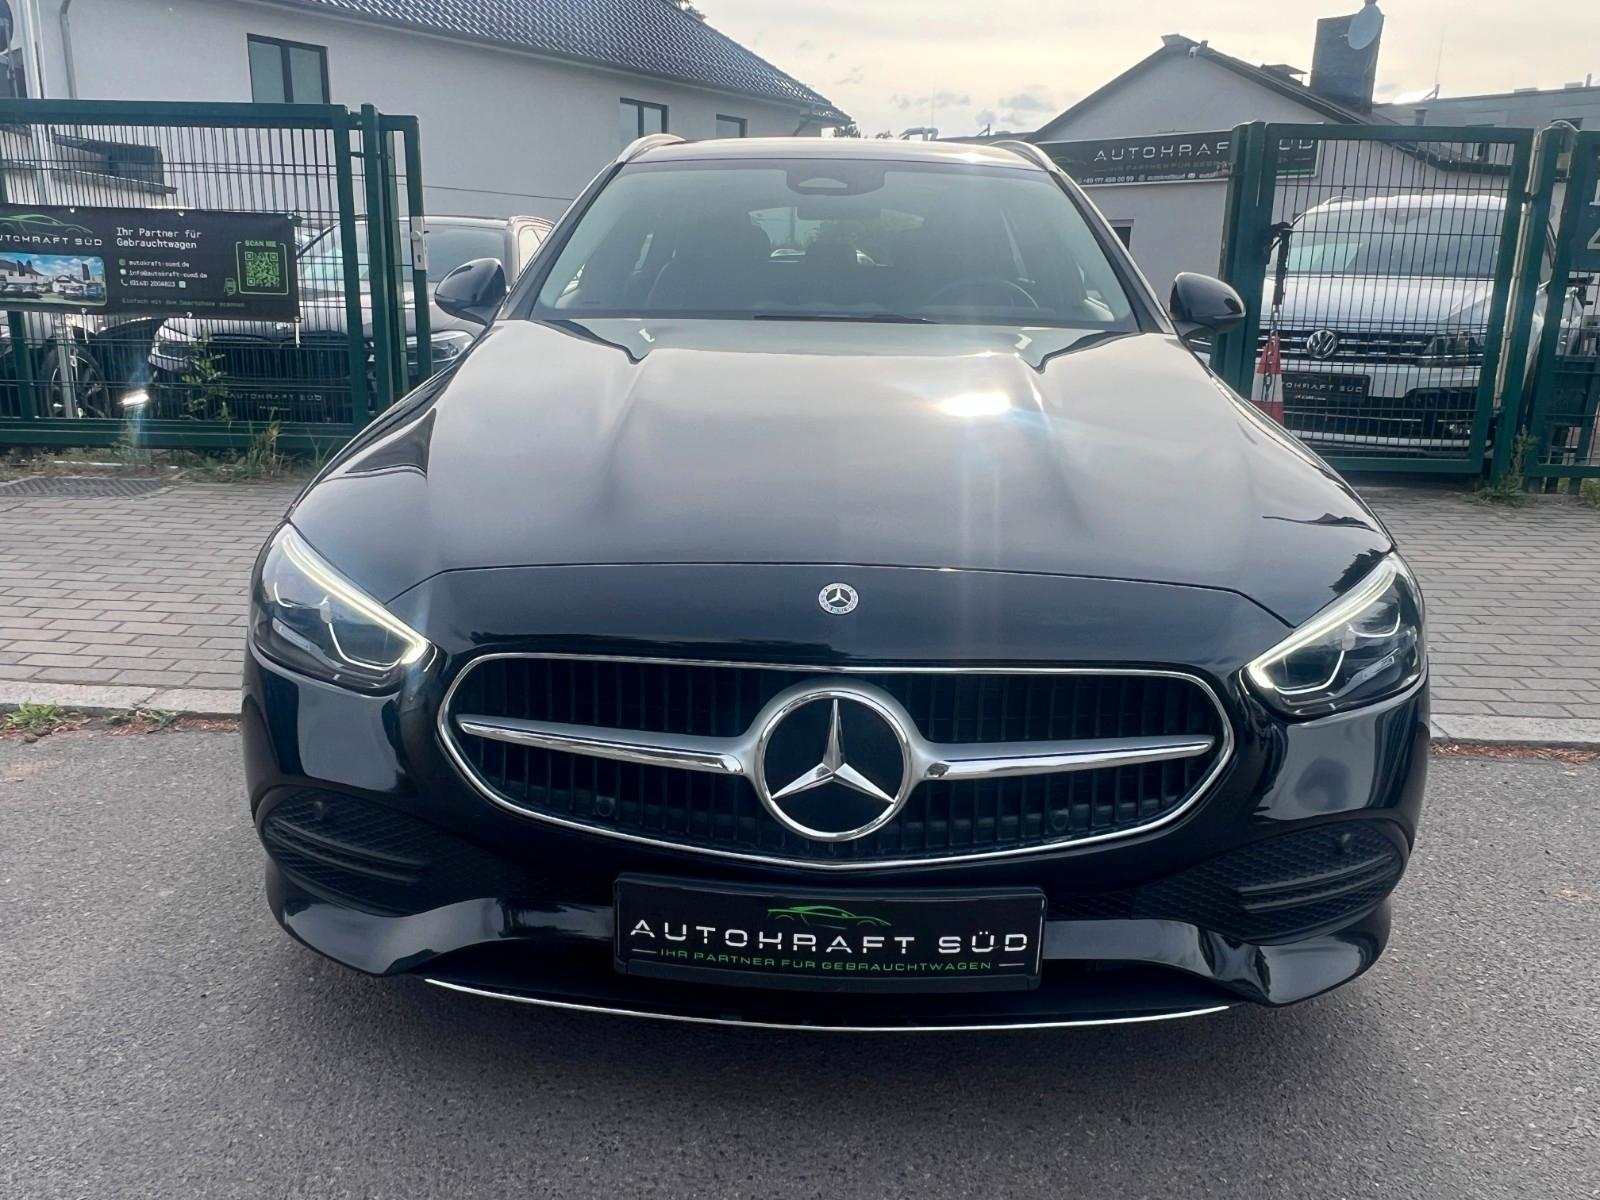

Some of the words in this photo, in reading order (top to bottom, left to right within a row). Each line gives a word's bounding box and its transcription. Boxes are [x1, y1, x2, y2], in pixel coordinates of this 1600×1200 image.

[116, 227, 134, 236] Ihr
[139, 228, 180, 238] Partner
[185, 229, 202, 239] für
[116, 237, 197, 250] Gebrauchtwagen
[245, 239, 265, 247] SCAN
[938, 930, 1028, 954] SÜD
[659, 948, 688, 958] IHR
[693, 952, 775, 967] PARTNER
[821, 961, 992, 972] GEBRAUCHTWAGEN
